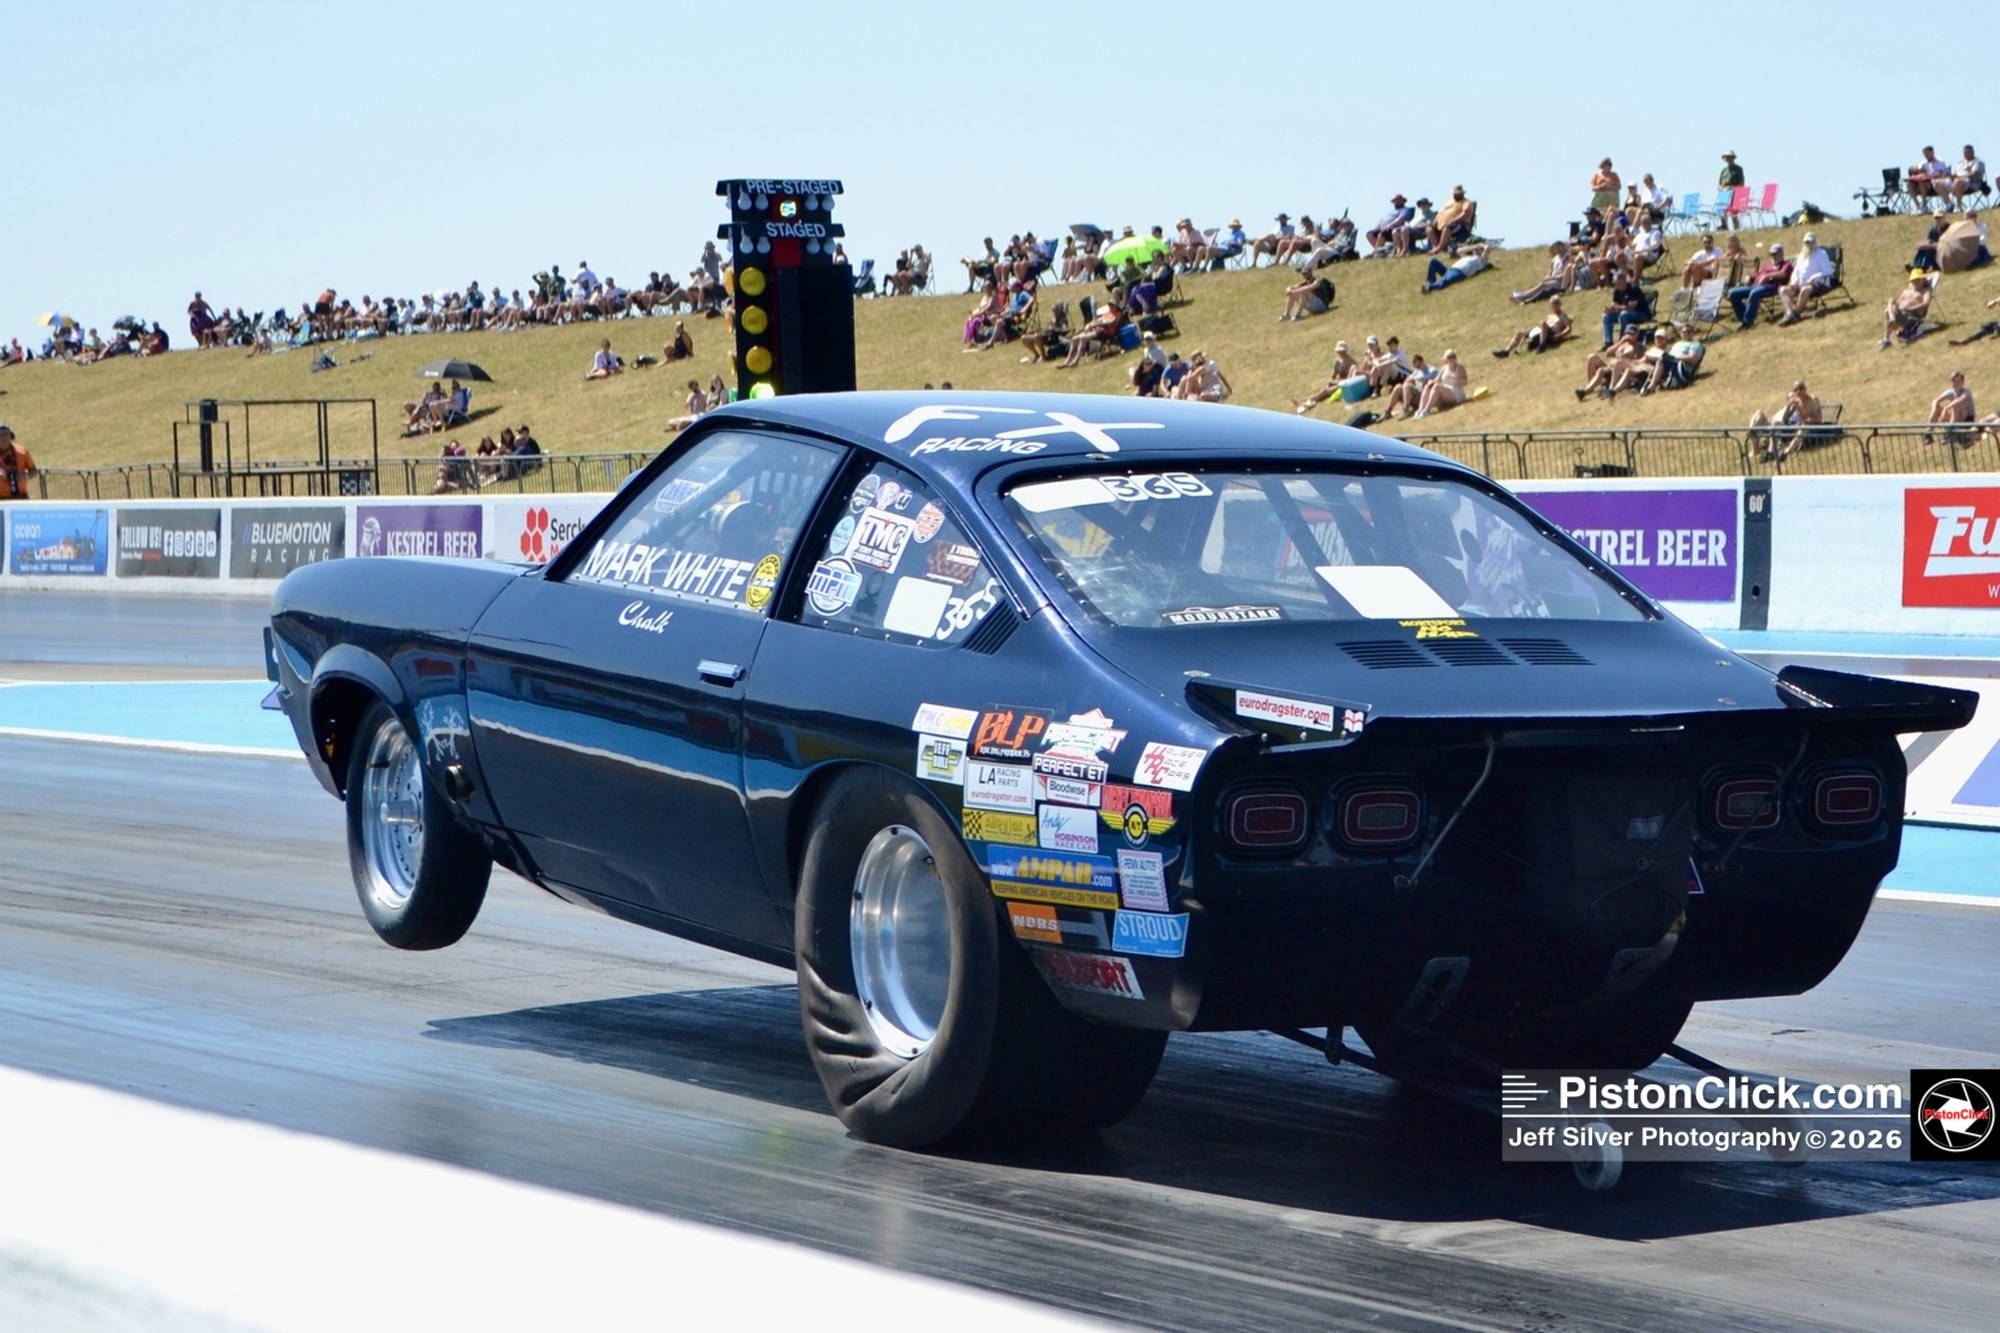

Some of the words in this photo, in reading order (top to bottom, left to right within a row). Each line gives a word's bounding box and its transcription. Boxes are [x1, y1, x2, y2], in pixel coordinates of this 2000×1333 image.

[745, 180, 839, 195] PRE-STAGED
[766, 222, 826, 238] STAGED
[910, 437, 1047, 457] RACING
[1103, 474, 1204, 498] 365
[121, 526, 149, 549] FOLLOW
[387, 530, 438, 558] KESTREL
[443, 530, 478, 558] BEER
[860, 518, 907, 554] TMC
[251, 548, 330, 564] RACING
[1657, 529, 1727, 567] BEER
[582, 539, 667, 585] MARK
[662, 550, 755, 600] WHITE
[618, 600, 674, 634] Chalk
[936, 577, 998, 640] 365
[1239, 697, 1330, 723] eurodragster.com
[978, 766, 996, 785] LA
[996, 767, 1021, 778] RACING
[1034, 757, 1088, 777] PERFECT
[1087, 765, 1105, 780] ET
[997, 777, 1019, 788] PARTS
[1049, 780, 1086, 796] Bloodwise
[971, 790, 1027, 803] eurodragster.com
[1054, 832, 1096, 844] ROBINSON
[1054, 841, 1075, 850] RACE
[1076, 843, 1097, 852] CARS
[1019, 886, 1048, 898] AMERICAN
[1076, 893, 1085, 902] ON
[1086, 894, 1098, 904] THE
[1098, 895, 1115, 906] ROAD
[1013, 915, 1058, 931] NDRS
[1119, 913, 1183, 941] STROUD
